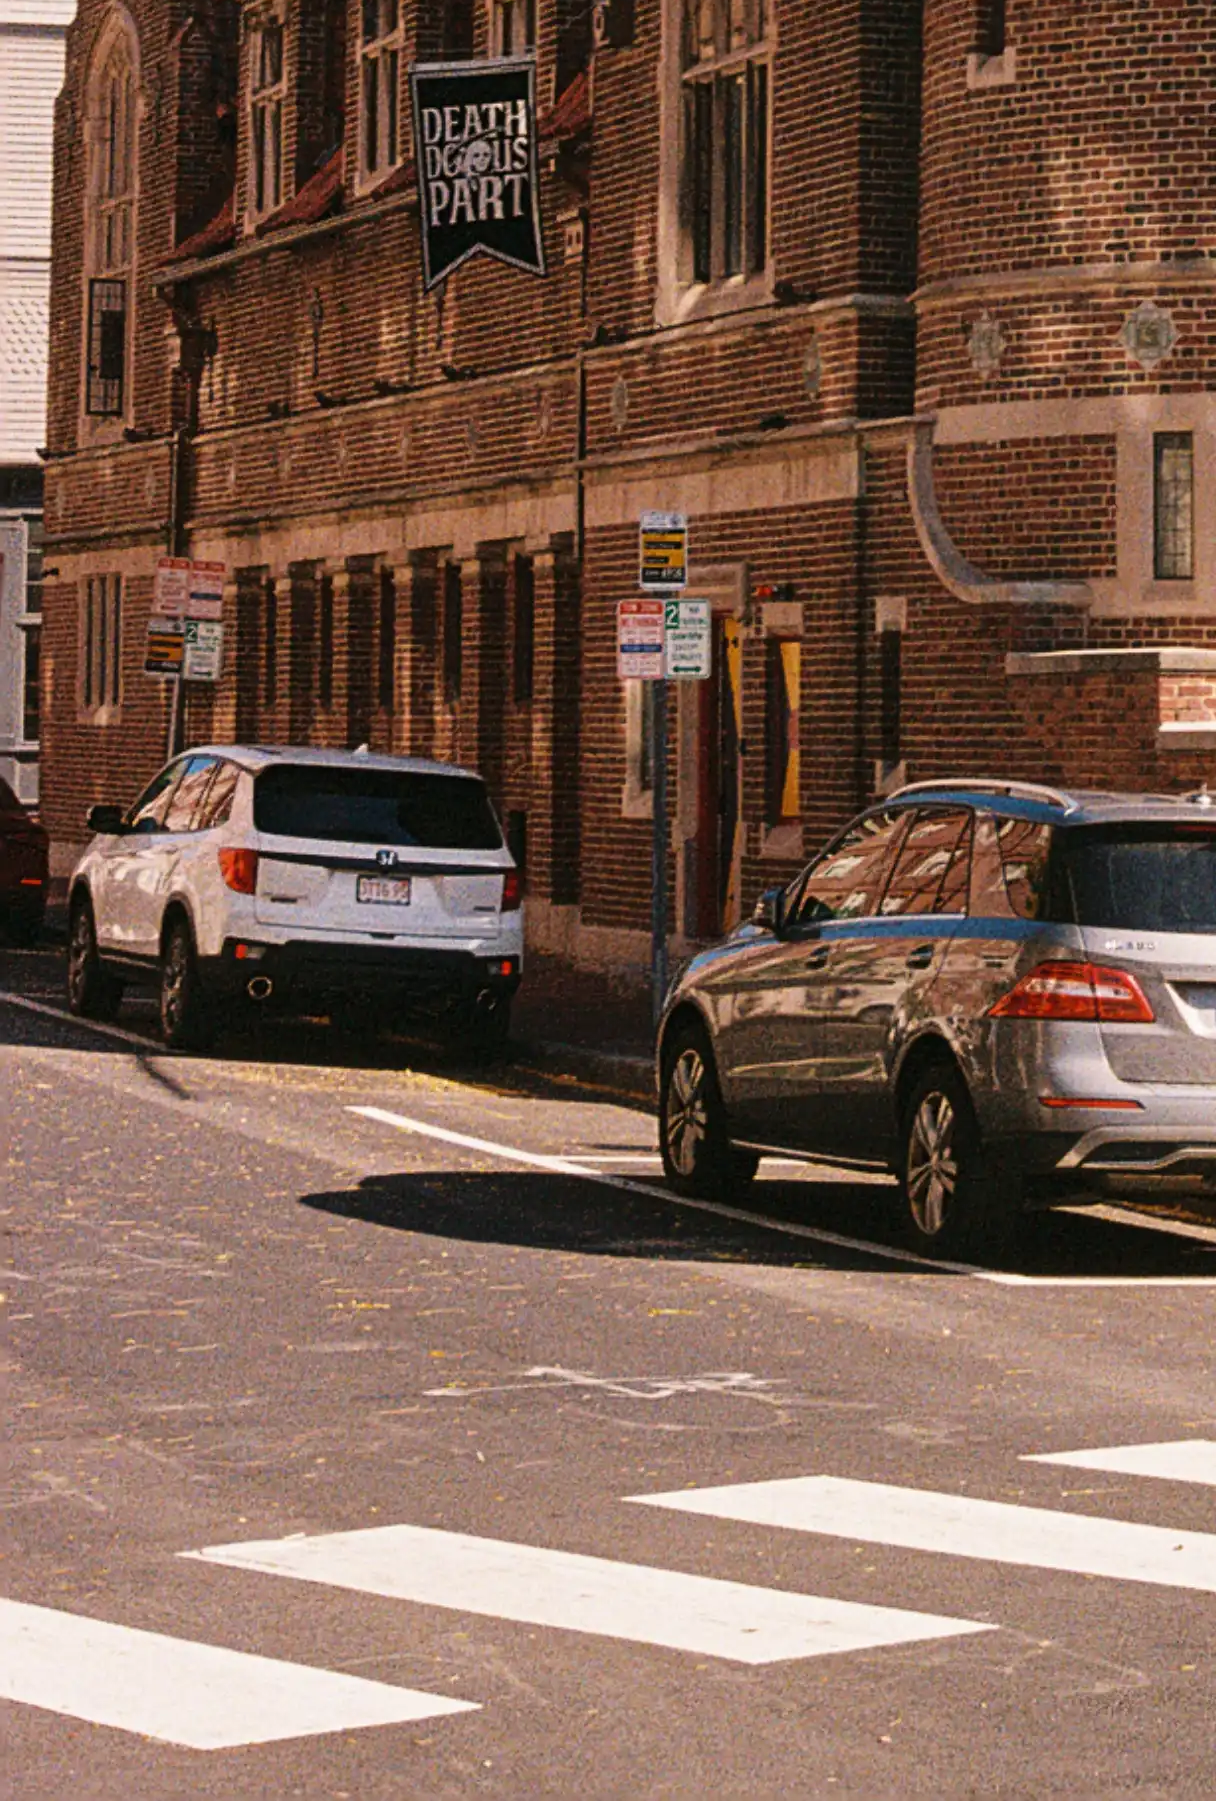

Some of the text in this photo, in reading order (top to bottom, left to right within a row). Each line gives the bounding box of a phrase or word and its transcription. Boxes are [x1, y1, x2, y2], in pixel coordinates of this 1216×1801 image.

[421, 99, 528, 144] DEATH
[491, 136, 529, 173] US
[428, 172, 530, 227] PART
[666, 604, 678, 625] 2
